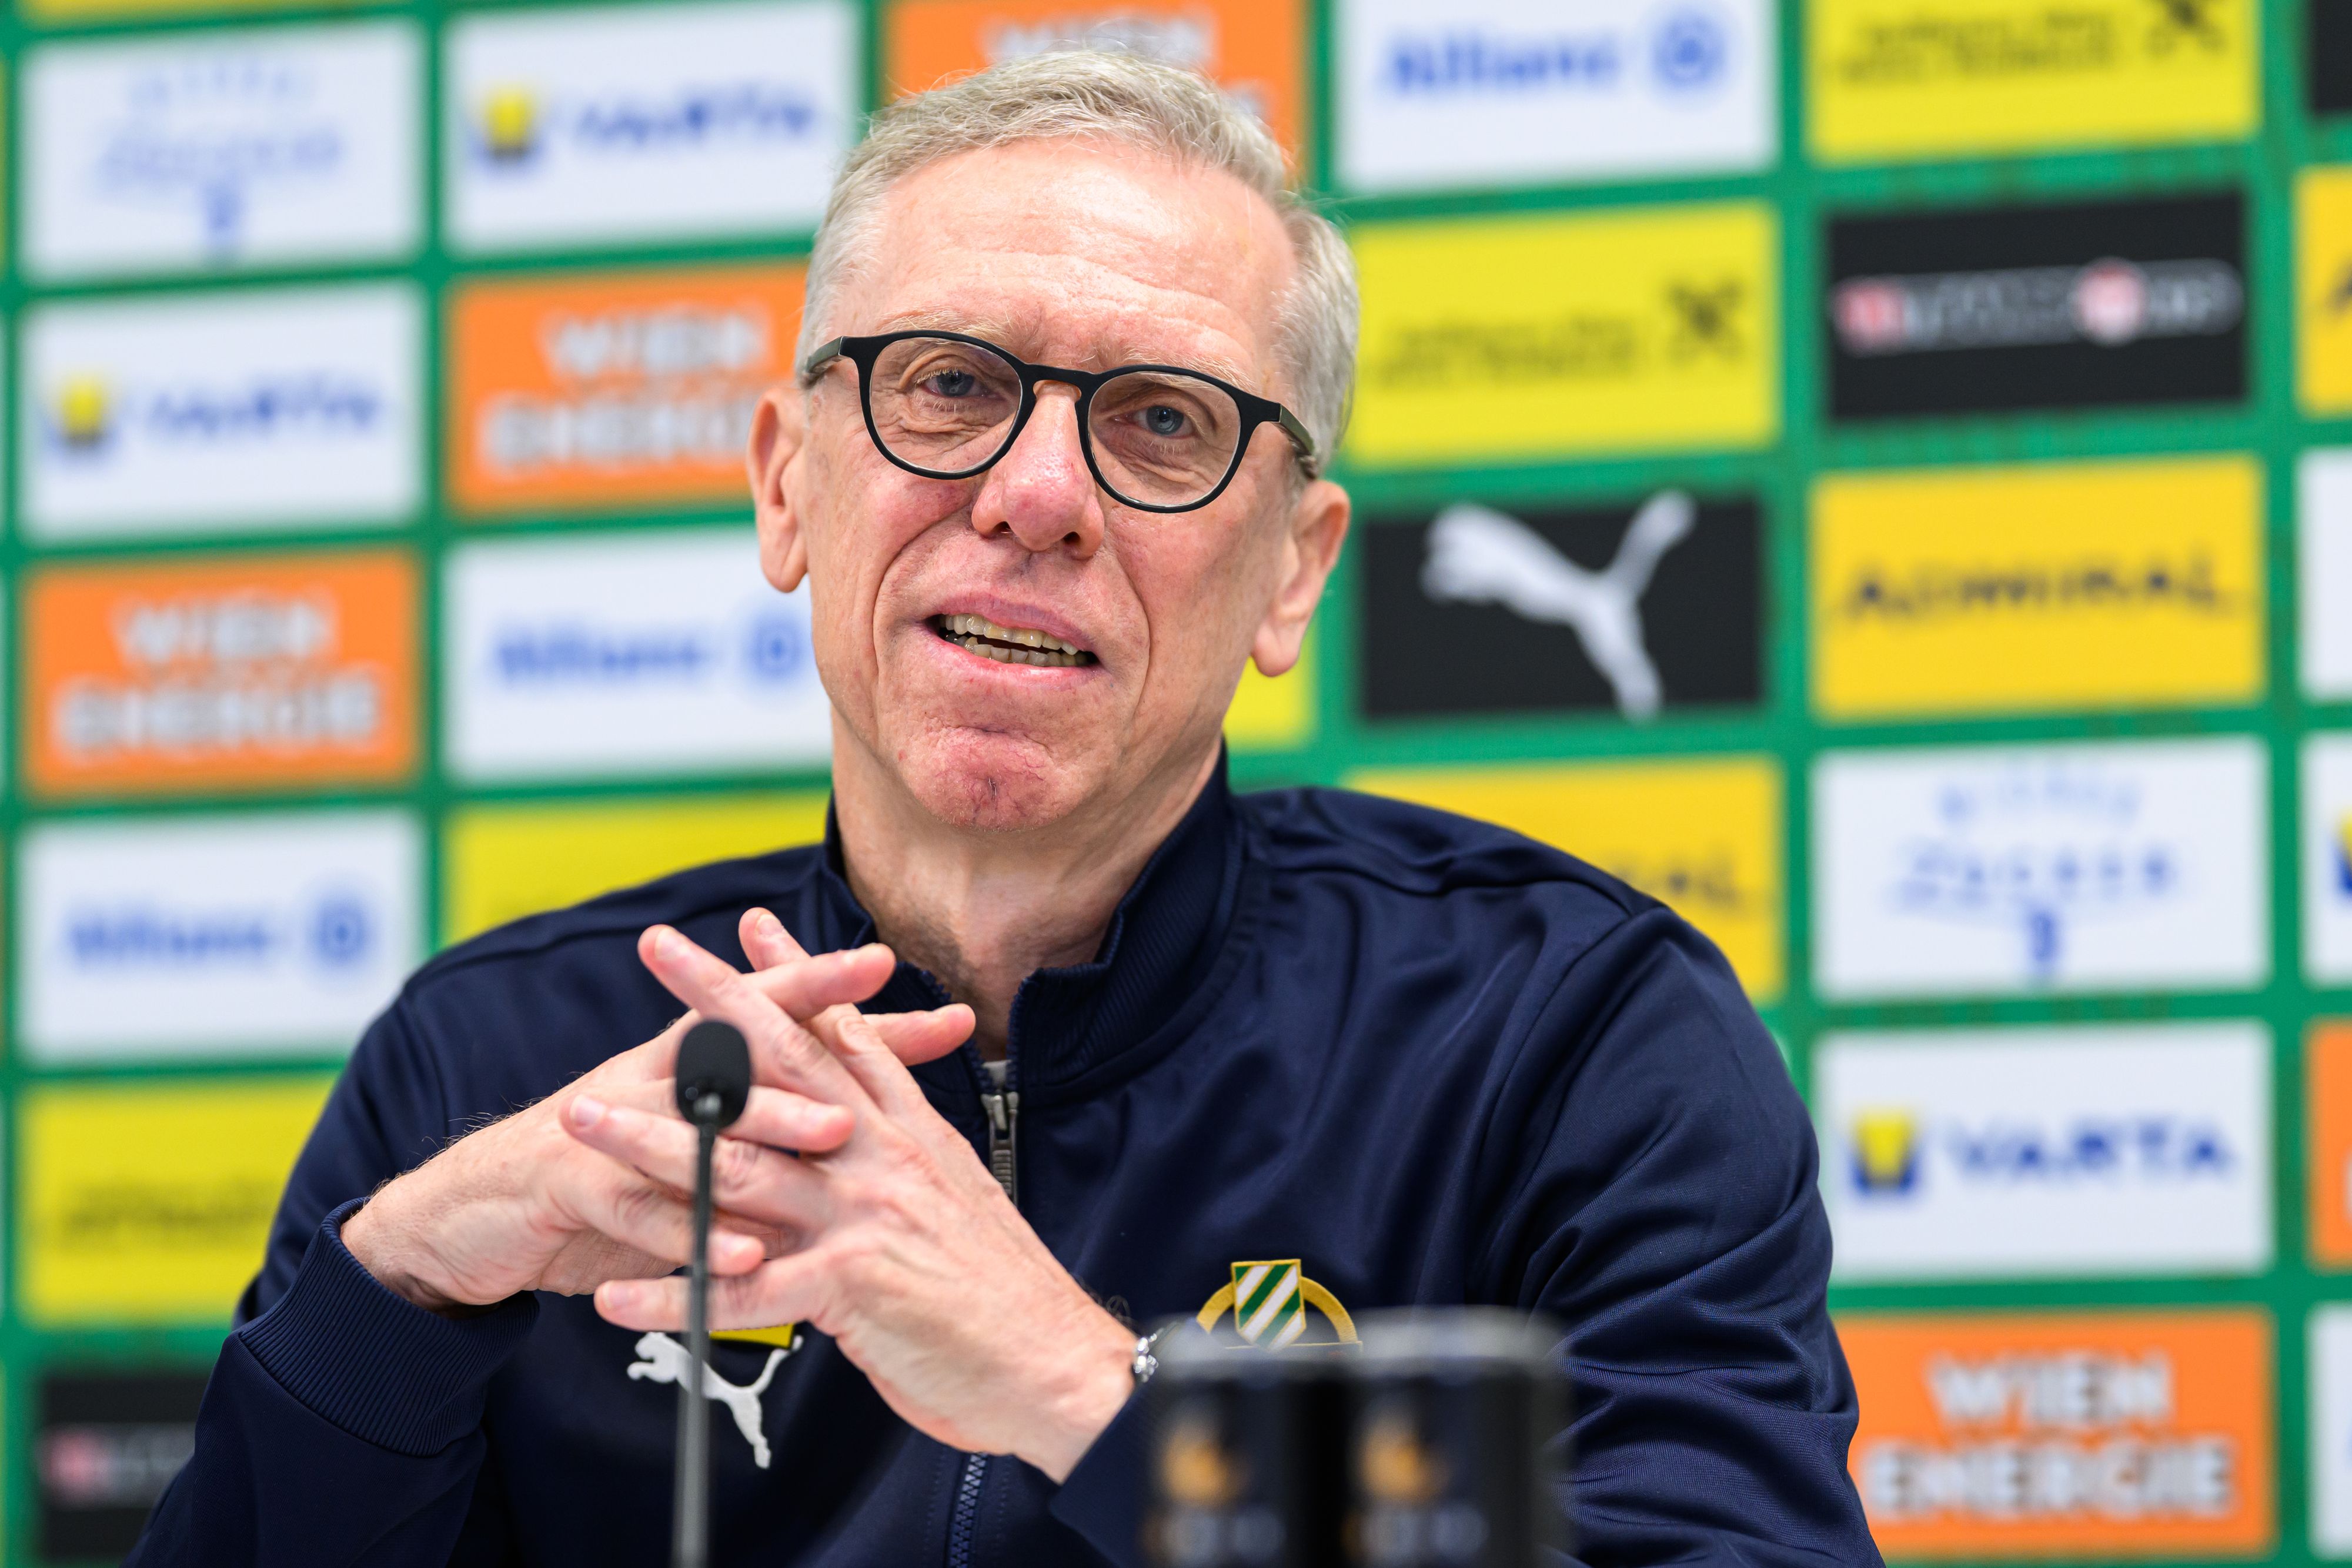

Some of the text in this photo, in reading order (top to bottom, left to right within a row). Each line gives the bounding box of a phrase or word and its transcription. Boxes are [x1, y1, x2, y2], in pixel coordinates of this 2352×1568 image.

[1942, 1112, 2236, 1181] VARTA
[1926, 1351, 2174, 1429] WIEN
[1863, 1436, 2237, 1520] ENERGIE
